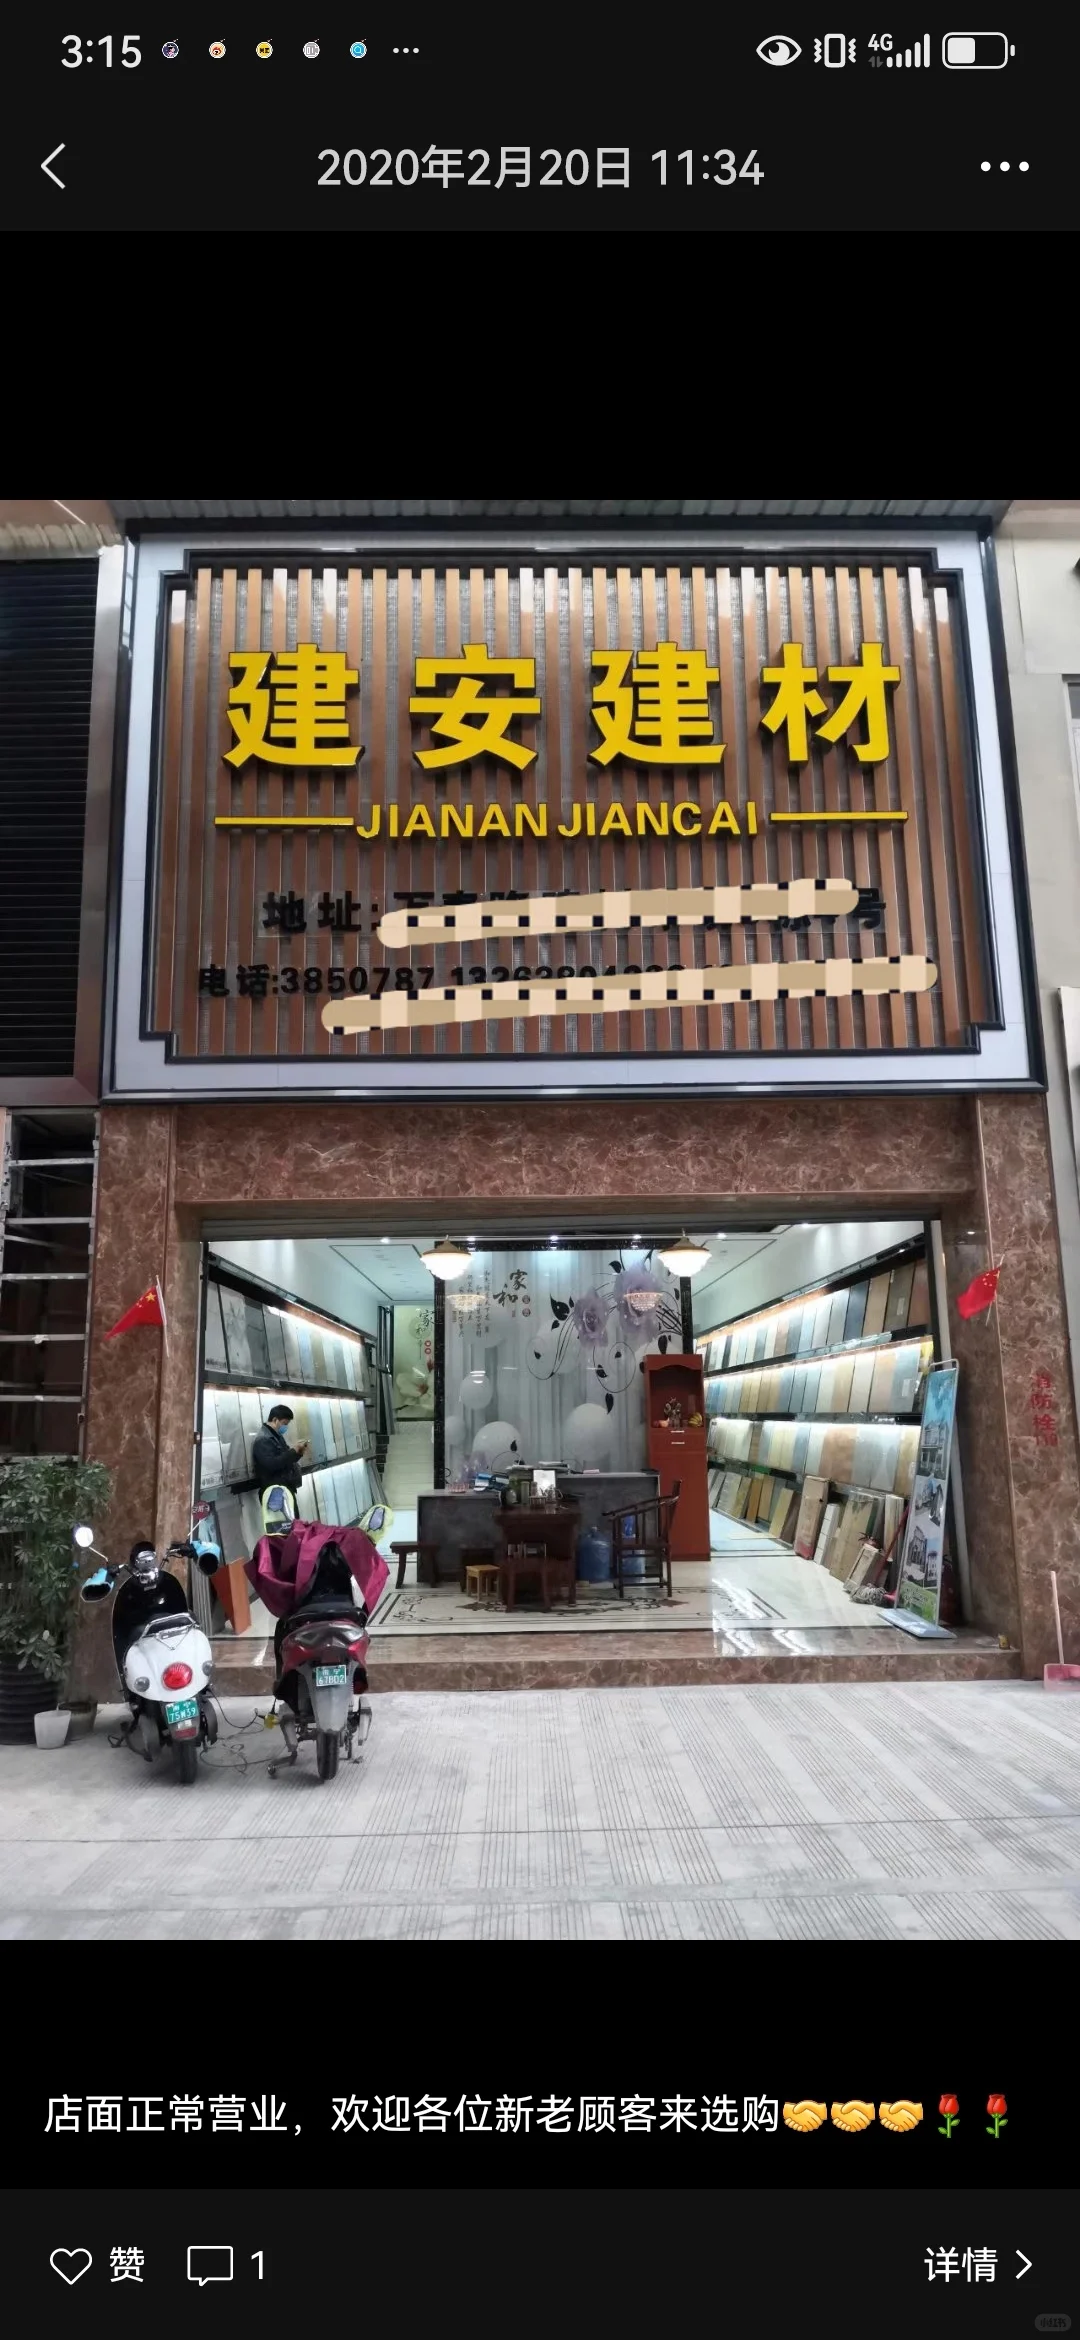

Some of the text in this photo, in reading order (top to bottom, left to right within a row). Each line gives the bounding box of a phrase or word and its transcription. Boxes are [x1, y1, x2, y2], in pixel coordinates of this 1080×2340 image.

[222, 641, 902, 770] 建安建材
[356, 800, 758, 838] JIANAN JIANCAI
